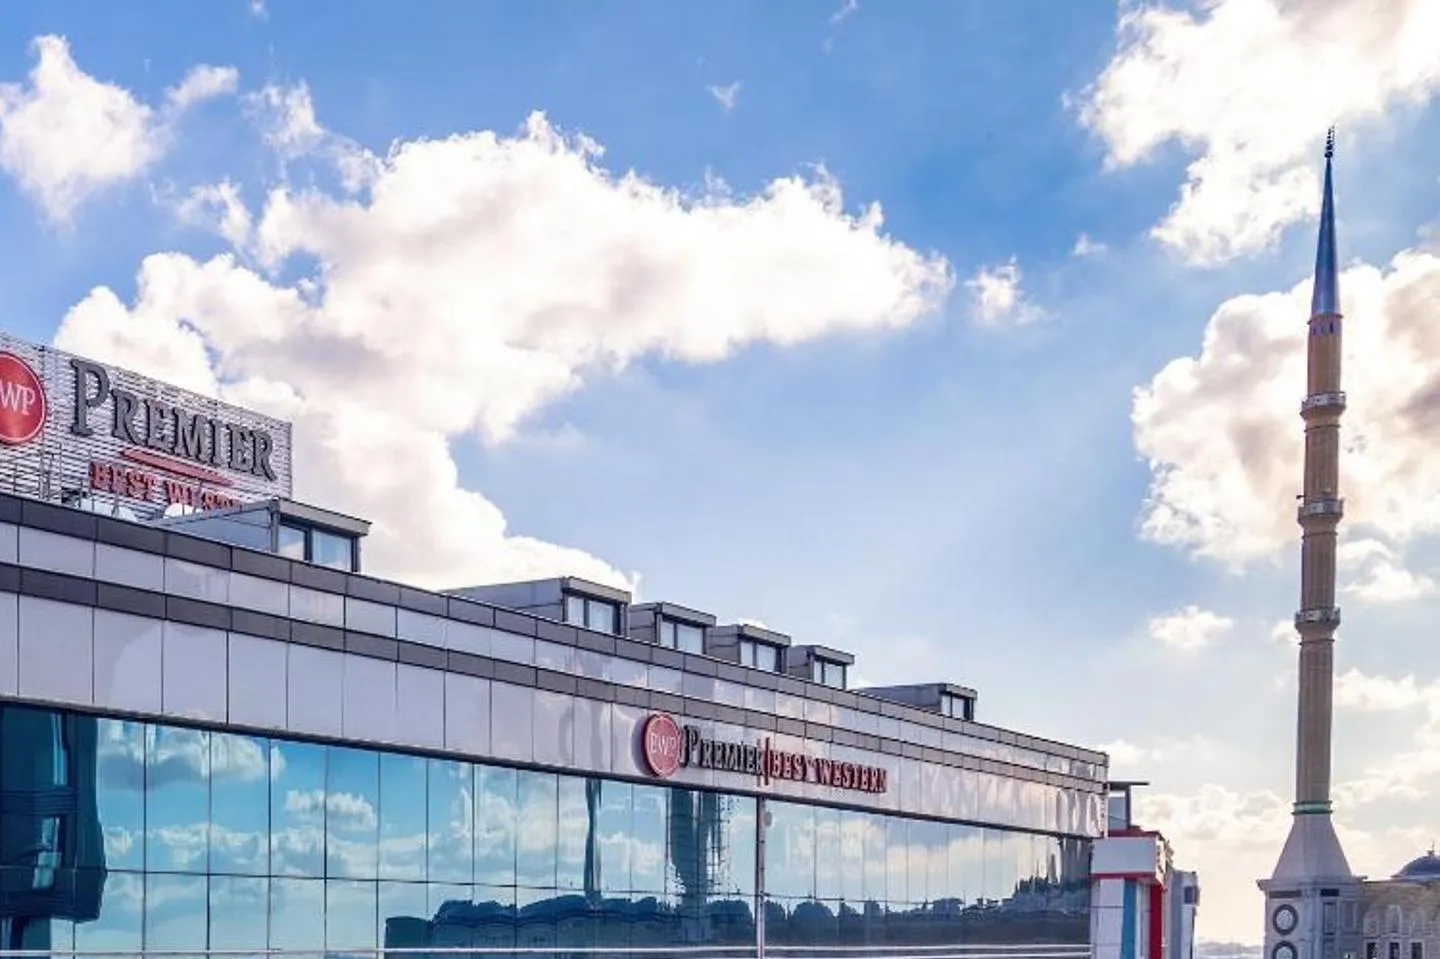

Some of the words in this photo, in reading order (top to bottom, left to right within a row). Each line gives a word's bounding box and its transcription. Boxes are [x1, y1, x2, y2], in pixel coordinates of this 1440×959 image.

[69, 358, 278, 482] PREMIER
[88, 459, 158, 502] BEST
[649, 733, 678, 756] BWP
[681, 724, 764, 776] PREMIER
[769, 751, 816, 783] BEST
[815, 757, 888, 794] WESTERN
